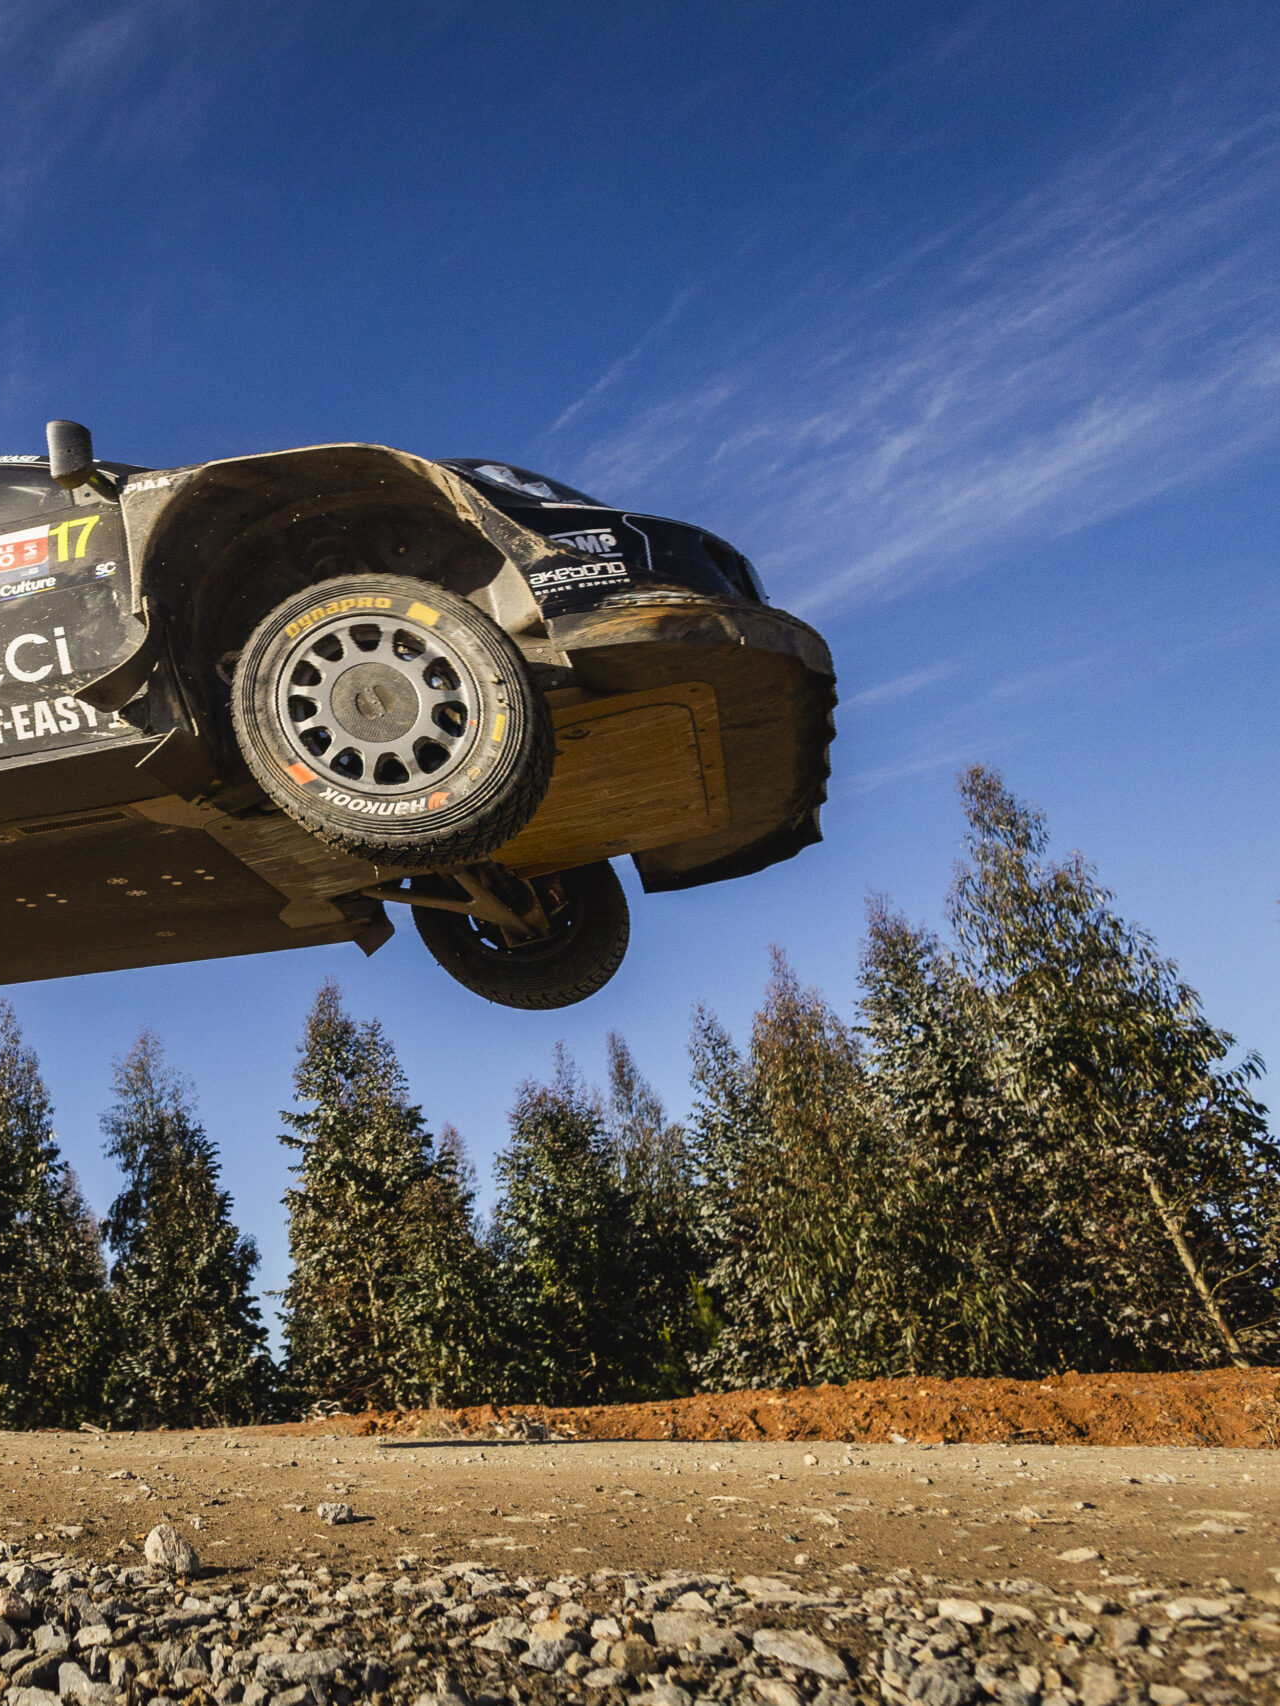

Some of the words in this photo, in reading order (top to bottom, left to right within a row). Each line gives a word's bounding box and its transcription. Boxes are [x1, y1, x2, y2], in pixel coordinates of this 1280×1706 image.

[123, 477, 171, 495] PIAA
[48, 515, 100, 562] 17
[95, 561, 117, 576] SC
[535, 584, 573, 596] BRAKE
[579, 577, 631, 588] EXPERTS
